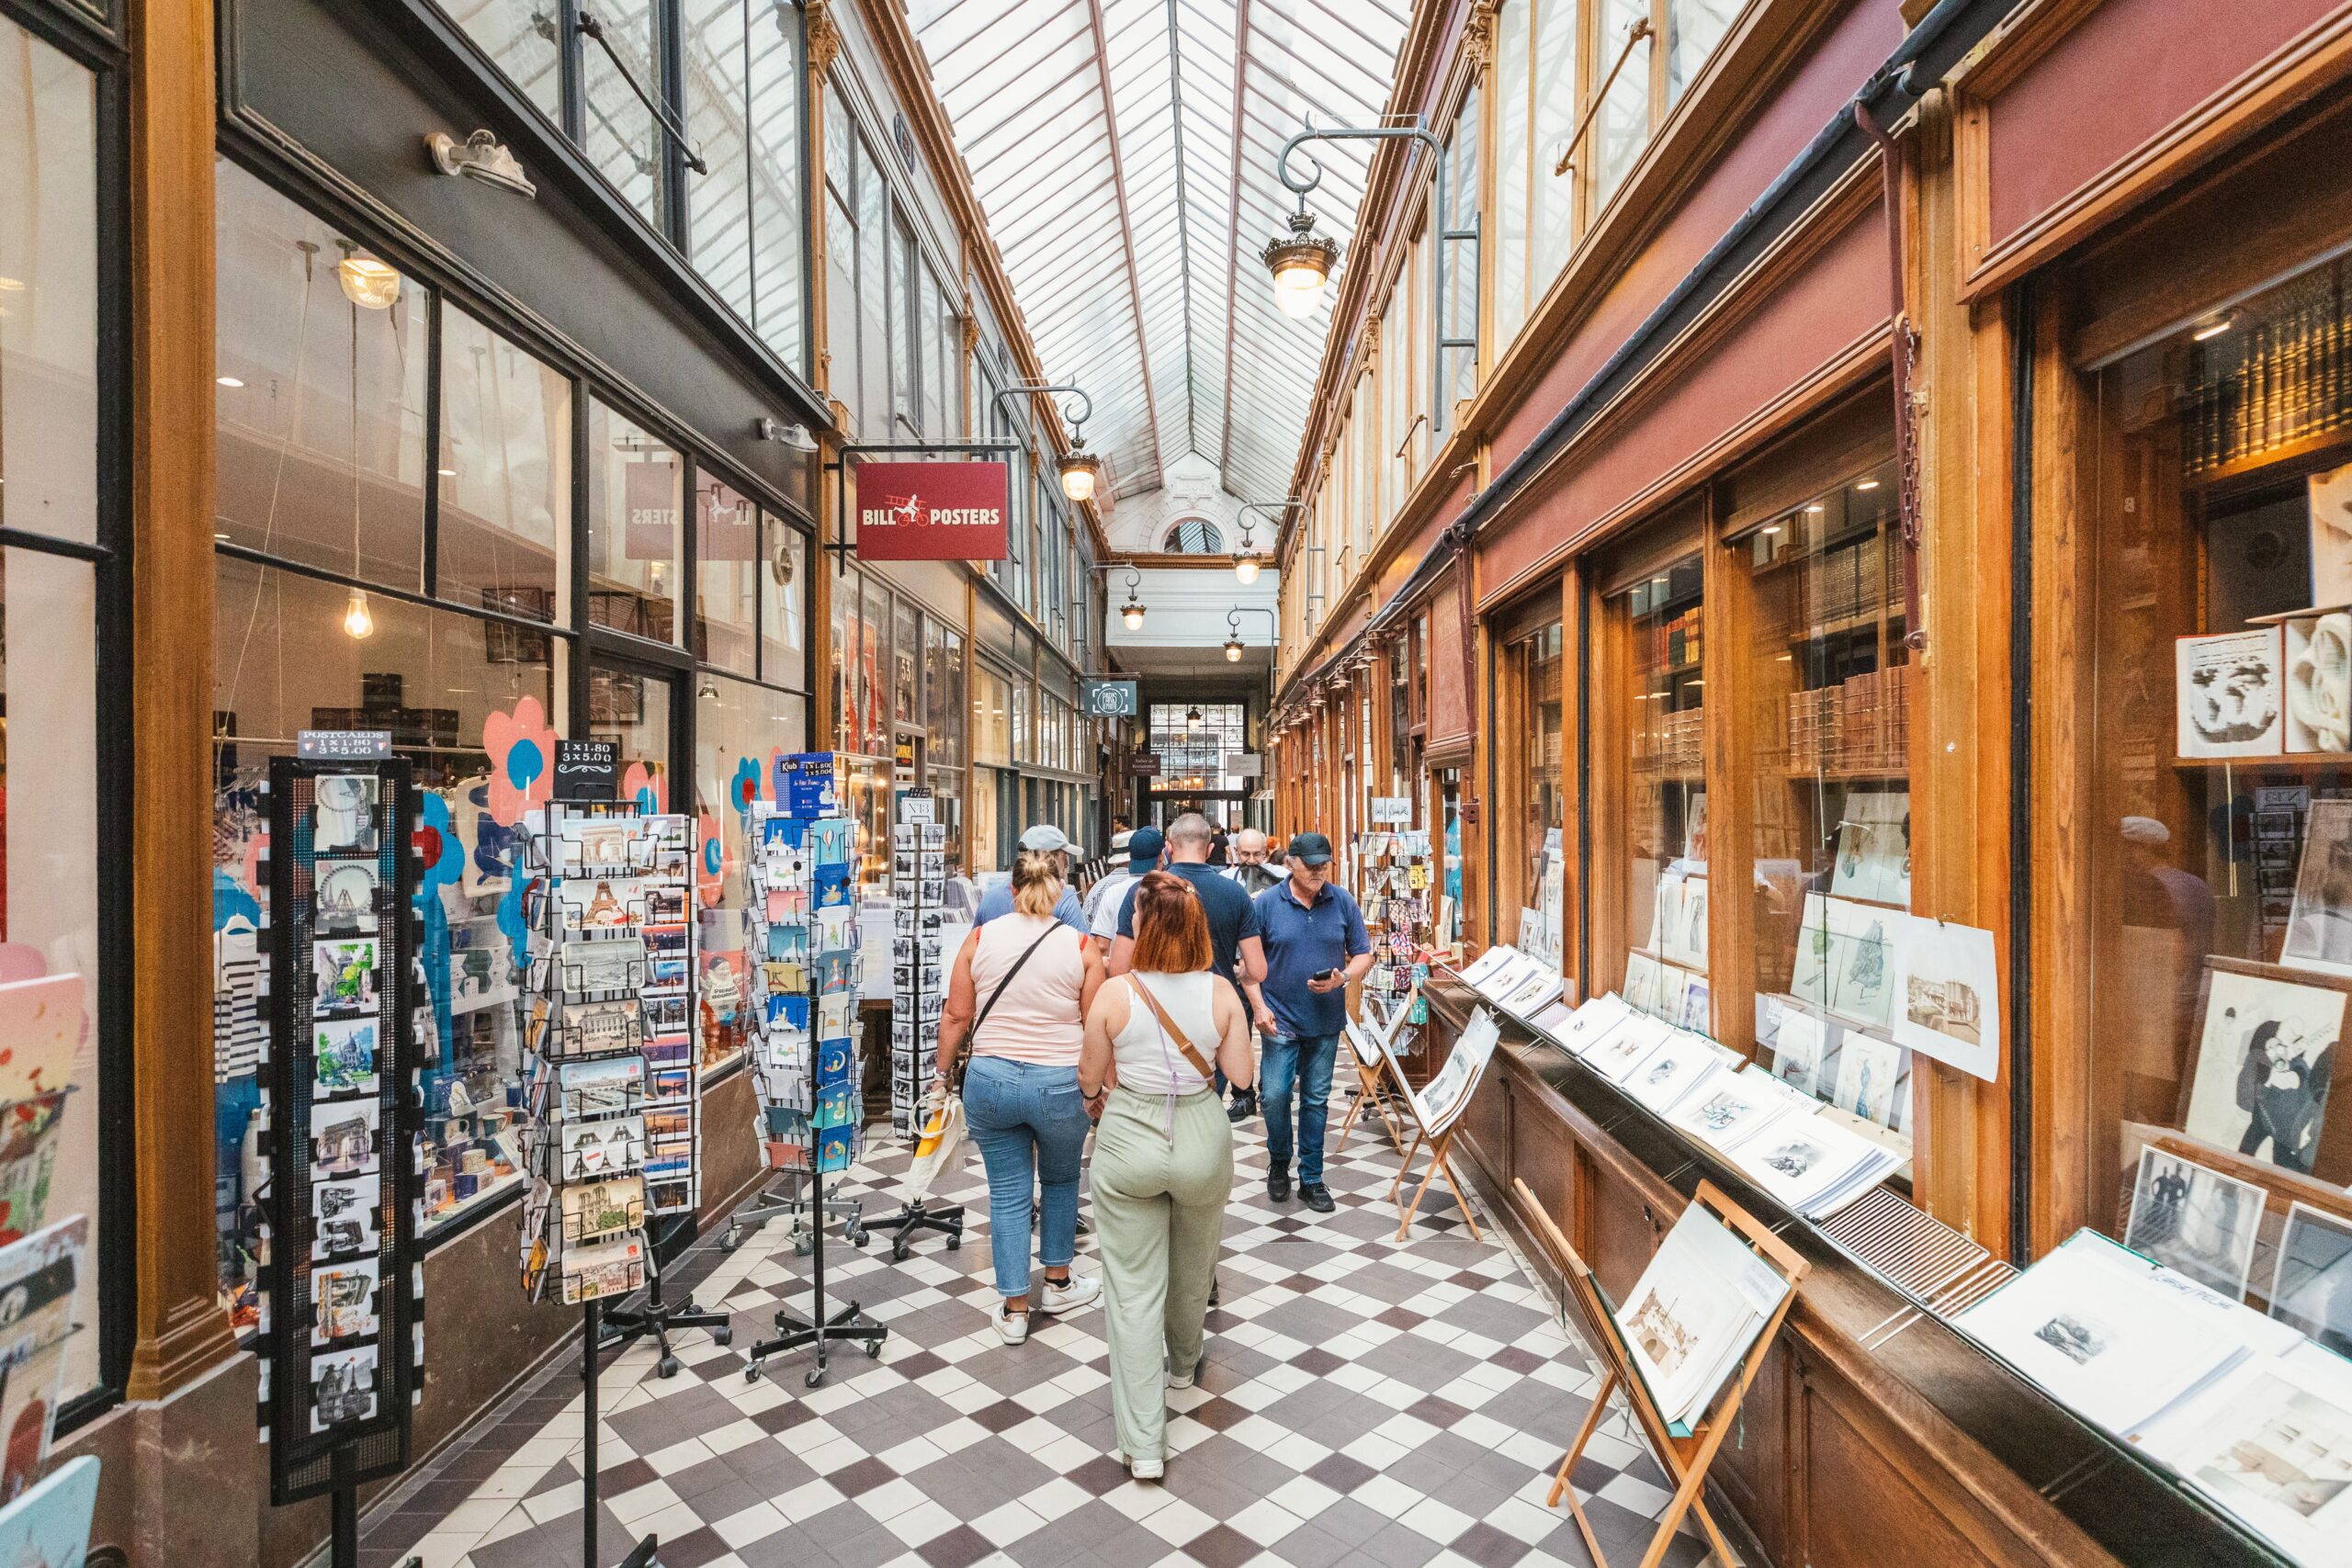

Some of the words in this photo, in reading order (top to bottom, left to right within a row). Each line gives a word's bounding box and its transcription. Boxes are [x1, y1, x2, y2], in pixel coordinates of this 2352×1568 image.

[863, 509, 897, 525] BILL
[930, 508, 1000, 525] POSTERS
[901, 658, 911, 682] 53
[564, 742, 569, 750] 1
[583, 743, 610, 752] 1.80
[562, 753, 570, 761] 3
[582, 752, 611, 762] 5.00
[782, 761, 797, 772] Kiub
